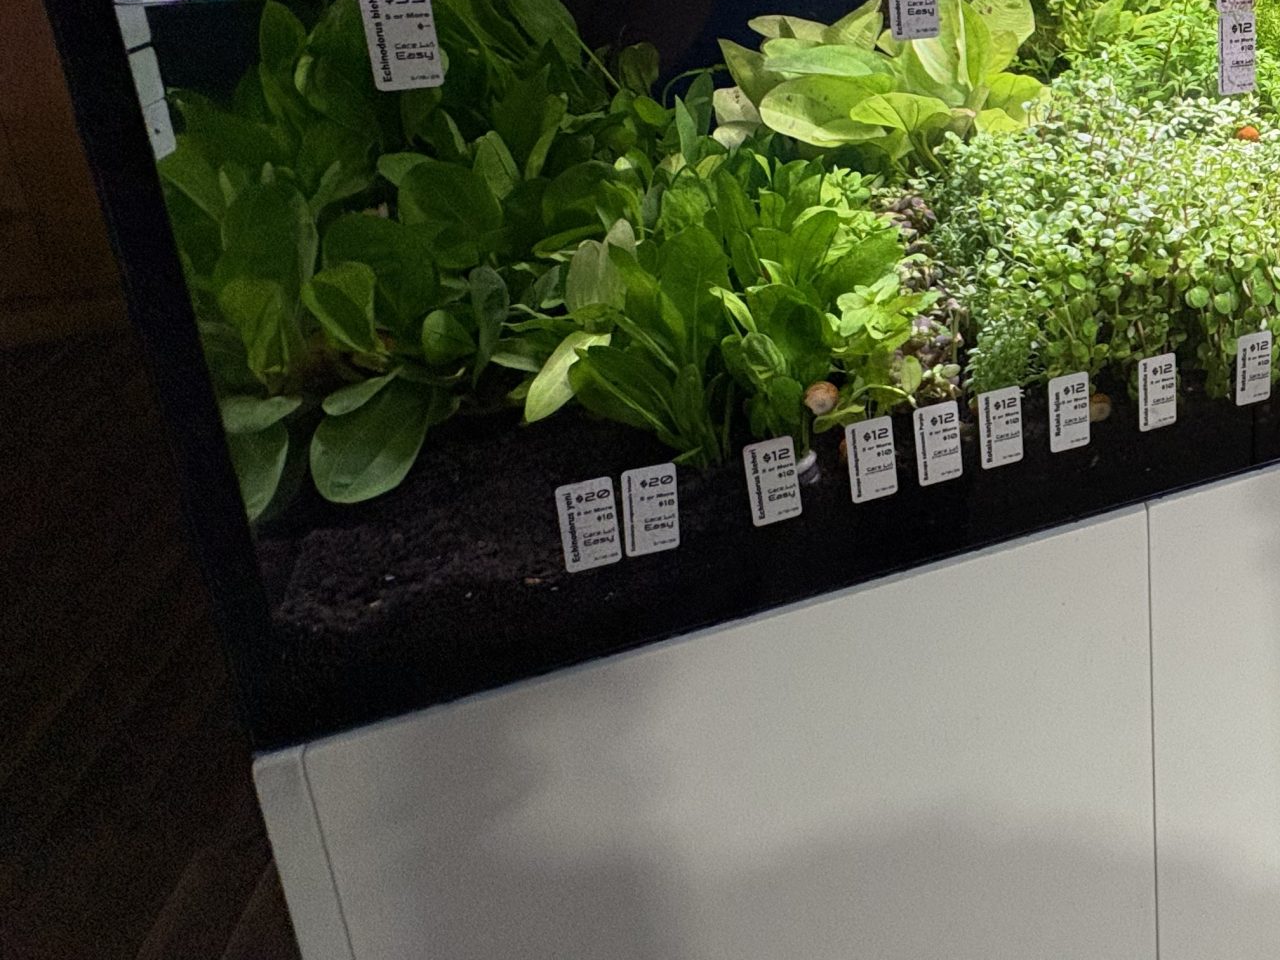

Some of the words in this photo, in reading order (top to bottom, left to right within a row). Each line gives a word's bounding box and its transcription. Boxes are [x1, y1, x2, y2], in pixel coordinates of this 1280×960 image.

[908, 8, 934, 16] Easy
[1232, 23, 1252, 34] $12
[376, 21, 392, 82] Echinodorus
[396, 52, 434, 60] Easy
[1250, 341, 1268, 352] $12
[1152, 364, 1173, 376] $12
[1064, 383, 1085, 395] $12
[994, 398, 1017, 410] $12
[931, 413, 954, 426] $12
[863, 428, 888, 442] $12
[763, 448, 790, 463] $12
[640, 475, 673, 489] $20
[576, 489, 610, 503] $20
